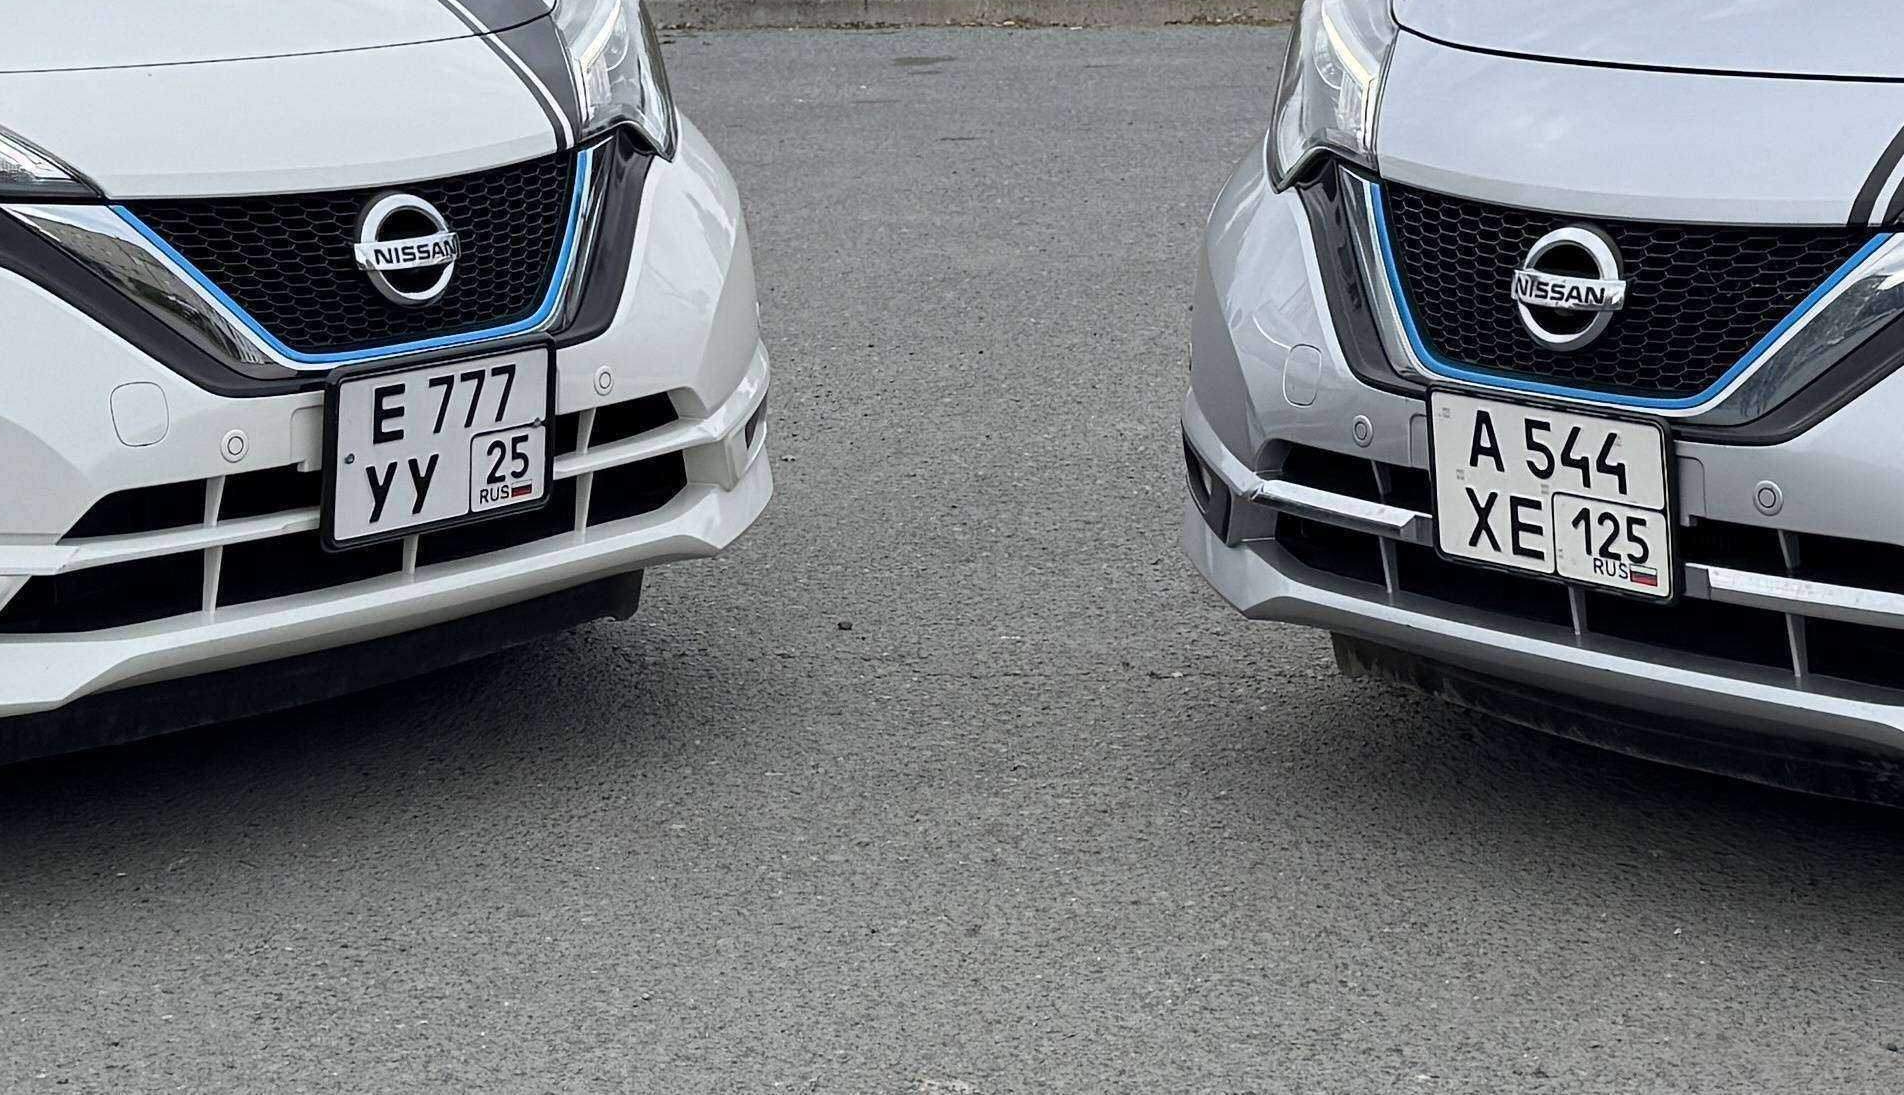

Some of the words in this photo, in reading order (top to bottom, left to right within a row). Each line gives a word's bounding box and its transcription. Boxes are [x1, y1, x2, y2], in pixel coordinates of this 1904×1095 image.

[373, 236, 460, 266] NISSAN
[1515, 275, 1607, 305] NISSAN
[428, 364, 517, 434] 777
[486, 434, 530, 486] 25
[1523, 417, 1628, 496] 544
[479, 485, 510, 504] RUS
[1571, 507, 1649, 564] 125
[1593, 557, 1629, 580] RUS
